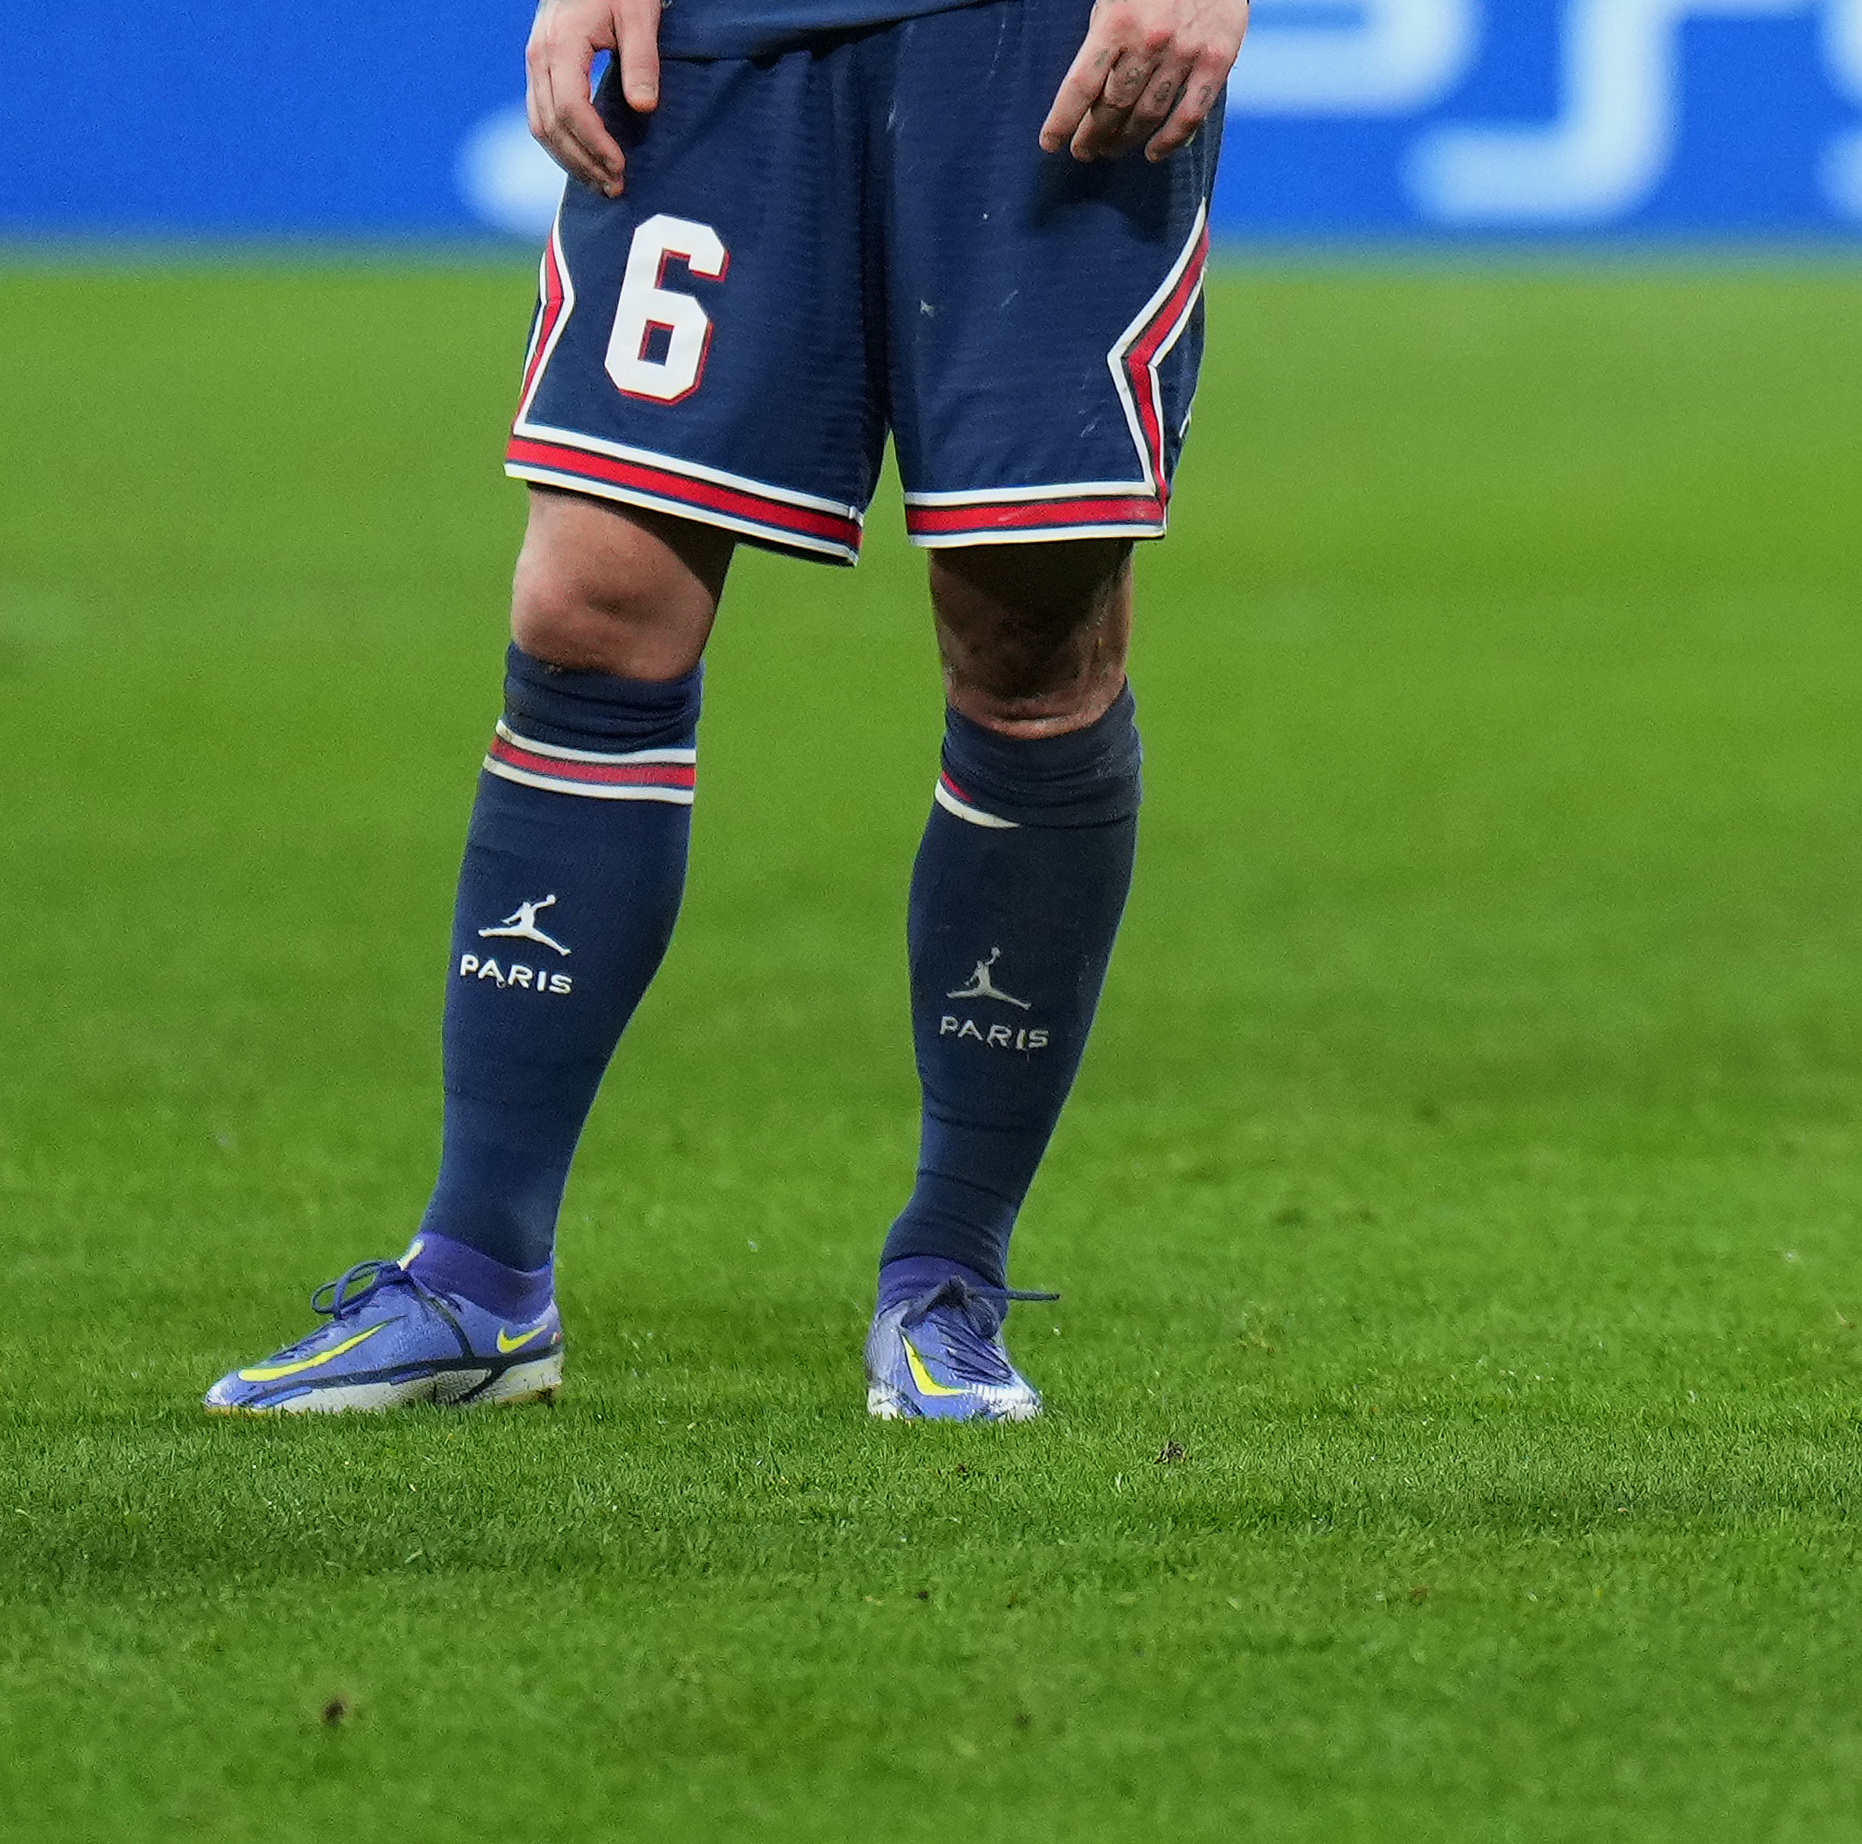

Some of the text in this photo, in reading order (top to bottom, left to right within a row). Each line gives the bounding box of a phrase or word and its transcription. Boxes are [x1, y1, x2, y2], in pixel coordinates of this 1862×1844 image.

[604, 213, 731, 406] 6
[459, 953, 573, 995] PARIS
[939, 1015, 1050, 1051] PARIS
